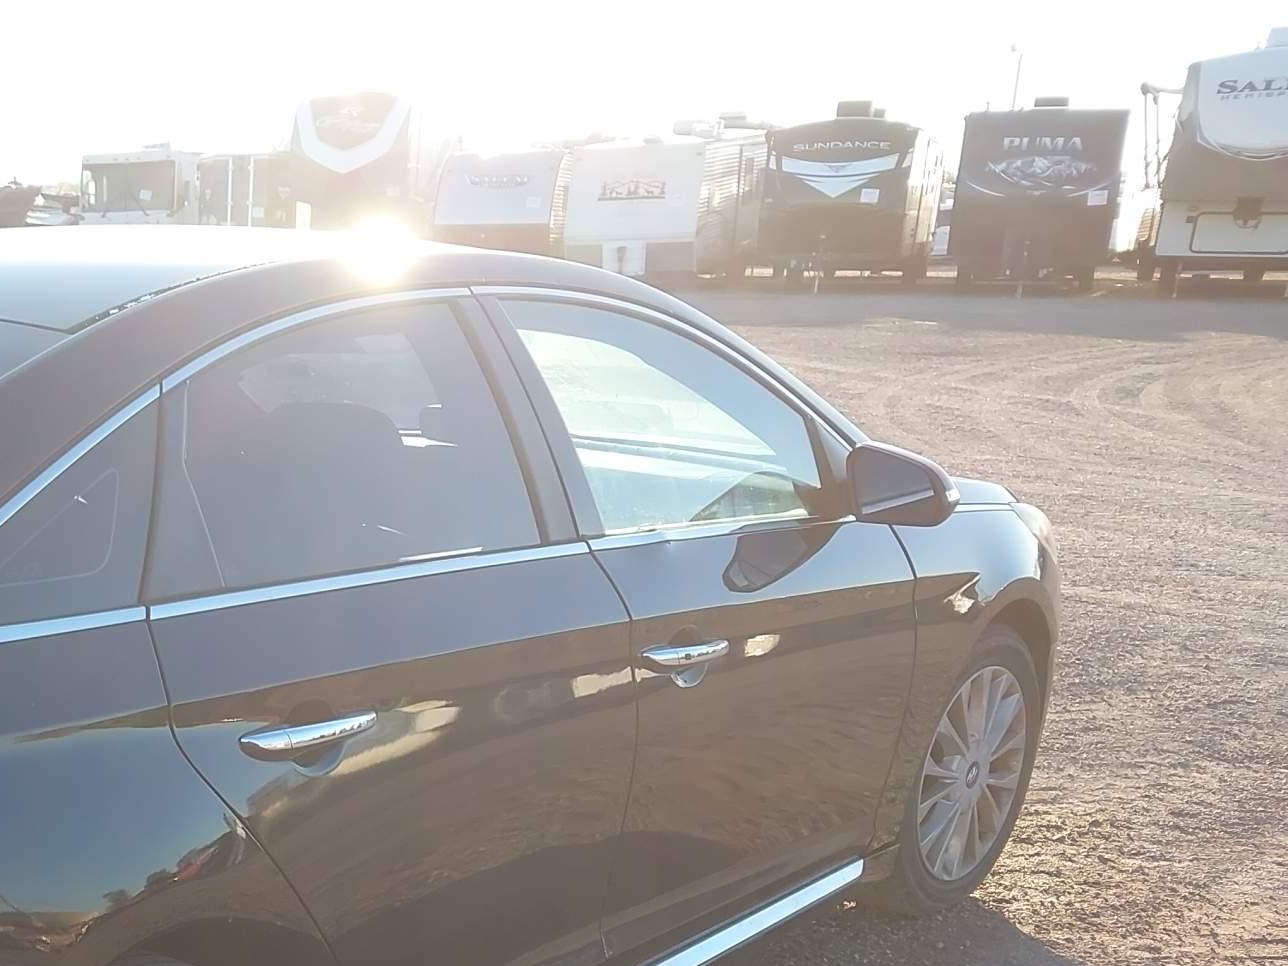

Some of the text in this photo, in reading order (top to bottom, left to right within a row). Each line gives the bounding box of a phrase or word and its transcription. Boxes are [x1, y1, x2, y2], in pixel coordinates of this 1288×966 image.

[1216, 79, 1288, 95] SAL
[792, 140, 893, 153] SUNDANCE
[1003, 136, 1083, 152] PUMA
